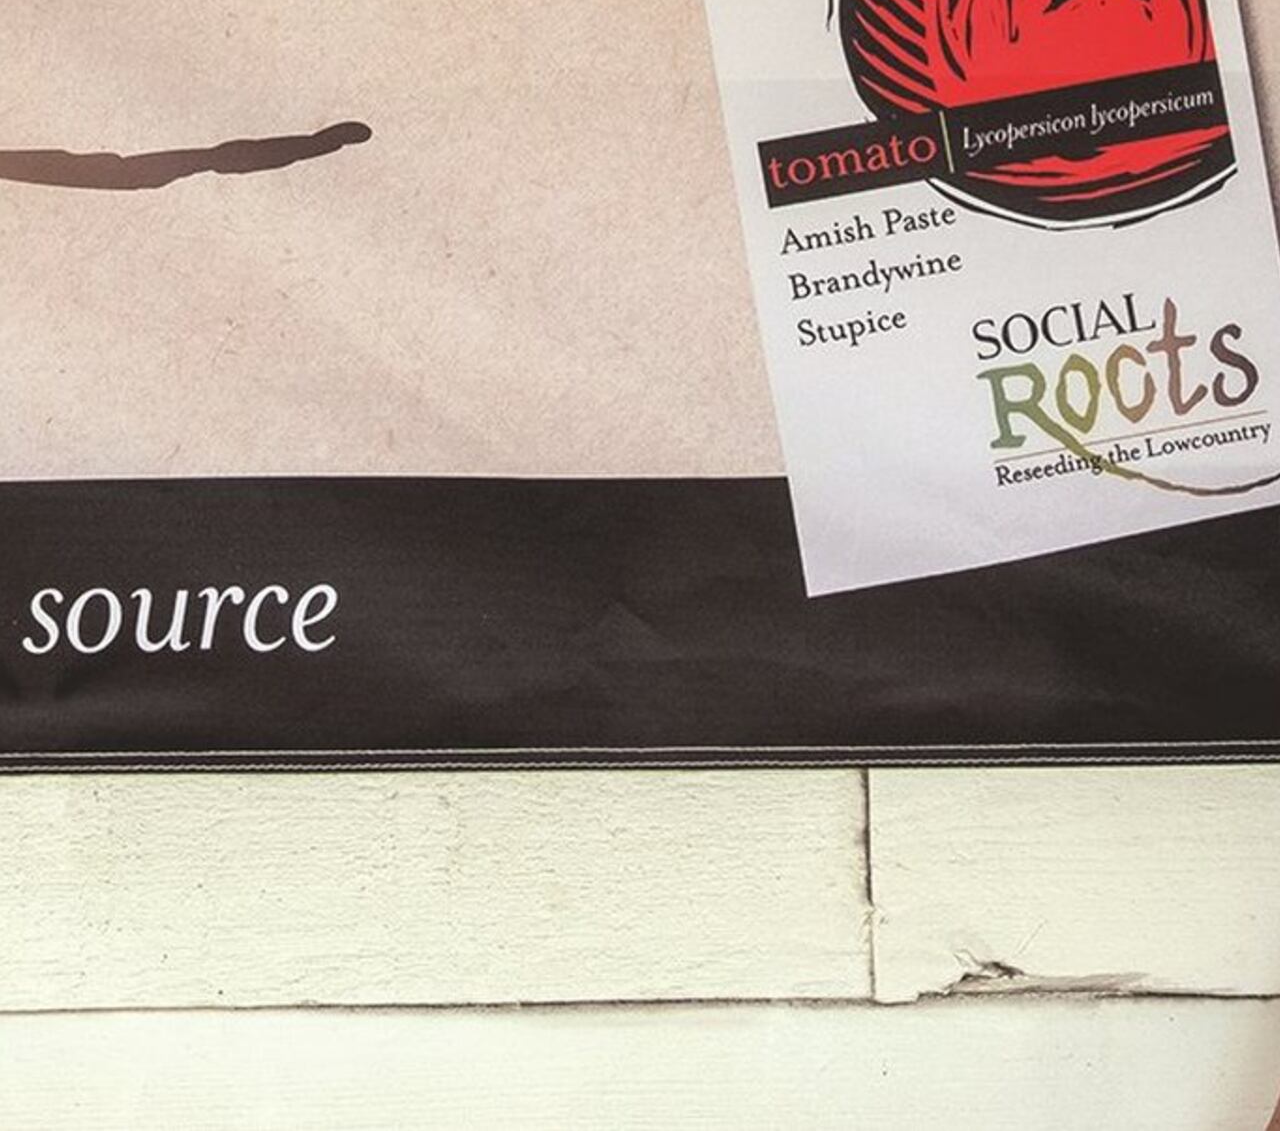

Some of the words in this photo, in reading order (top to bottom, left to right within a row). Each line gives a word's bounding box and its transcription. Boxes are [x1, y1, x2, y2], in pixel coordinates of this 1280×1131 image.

[961, 110, 1087, 158] Lycopersicon
[1090, 86, 1214, 134] lycopersicum
[767, 133, 937, 189] tomato
[780, 216, 874, 256] Amish
[884, 203, 956, 236] Paste
[789, 249, 964, 301] Brandywine
[797, 308, 907, 348] Stupice
[971, 292, 1156, 361] SOCIAL
[994, 445, 1102, 488] Reseeding
[1108, 441, 1140, 467] the
[1144, 422, 1272, 460] Lowcountry
[21, 582, 338, 655] source
